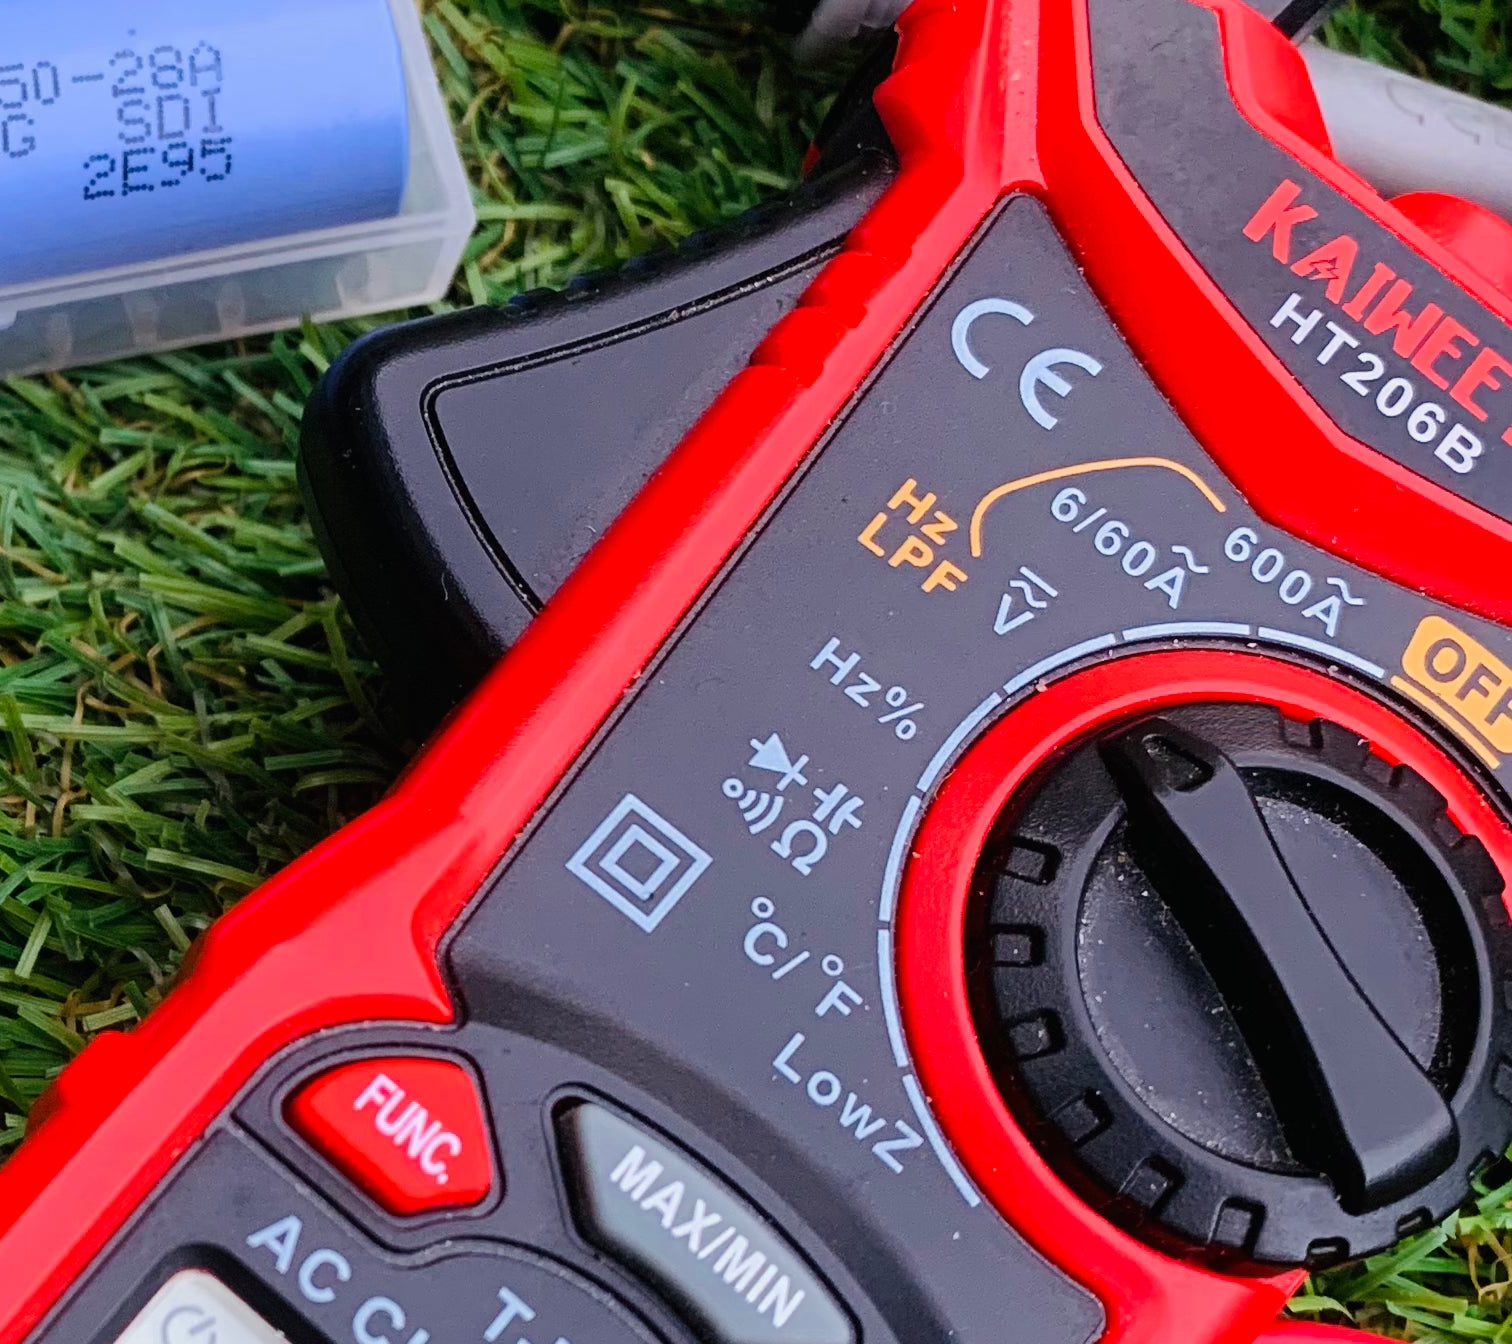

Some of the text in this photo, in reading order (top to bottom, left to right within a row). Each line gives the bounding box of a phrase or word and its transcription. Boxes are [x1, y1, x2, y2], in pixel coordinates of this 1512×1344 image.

[117, 87, 224, 144] SDI
[83, 137, 232, 200] 2E95
[1242, 178, 1512, 447] KAIWEE
[951, 297, 1102, 430] CE
[1269, 292, 1484, 475] HT206B
[857, 512, 968, 592] LPF
[887, 479, 959, 545] Hz
[809, 637, 924, 740] Hz%
[1424, 638, 1512, 726] OFF
[353, 1072, 463, 1185] FUNC.
[246, 1214, 352, 1304] AC
[609, 1145, 806, 1329] MAX/MIN
